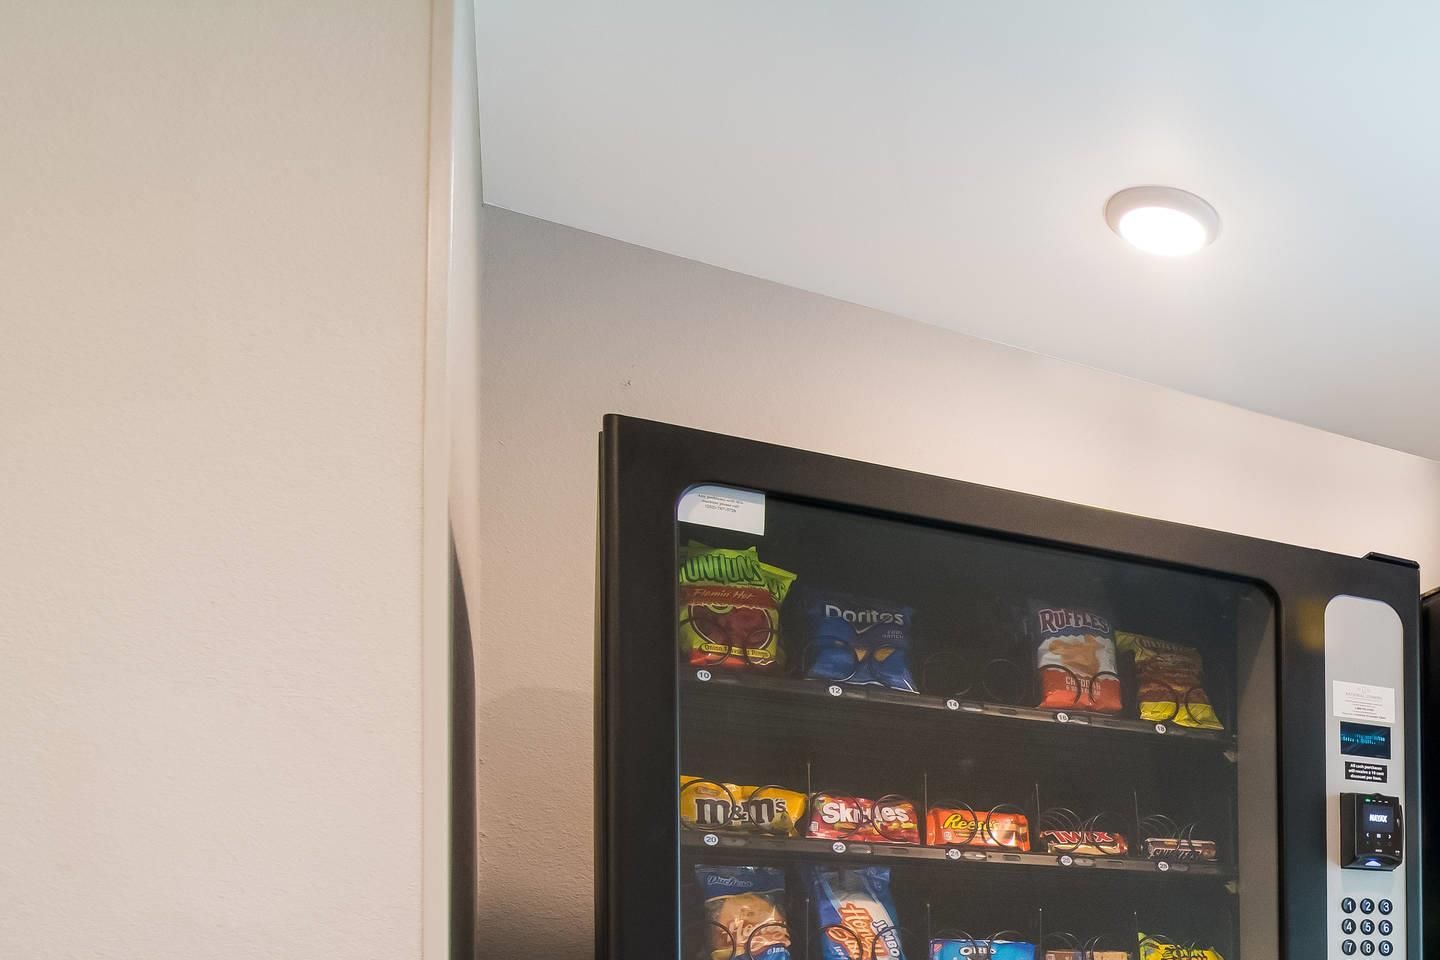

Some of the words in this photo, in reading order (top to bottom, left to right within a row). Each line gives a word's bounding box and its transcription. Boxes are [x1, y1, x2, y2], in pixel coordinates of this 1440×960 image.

[825, 604, 904, 626] Doritos
[1038, 608, 1110, 634] RUFFLES
[699, 672, 710, 680] 10
[830, 687, 841, 695] 12
[1058, 713, 1068, 722] 16
[944, 813, 1000, 831] Reese's
[1369, 814, 1388, 823] NAYAX
[705, 835, 717, 844] 20
[950, 850, 960, 858] 24
[1347, 901, 1352, 911] 1
[1365, 901, 1372, 912] 2
[1383, 902, 1390, 912] 3
[1346, 921, 1353, 932] 4
[1365, 922, 1371, 932] 5
[1383, 923, 1390, 933] 6
[872, 920, 900, 958] JUMBO
[1347, 942, 1353, 953] 7
[1365, 943, 1371, 953] 8
[1383, 943, 1390, 954] 9
